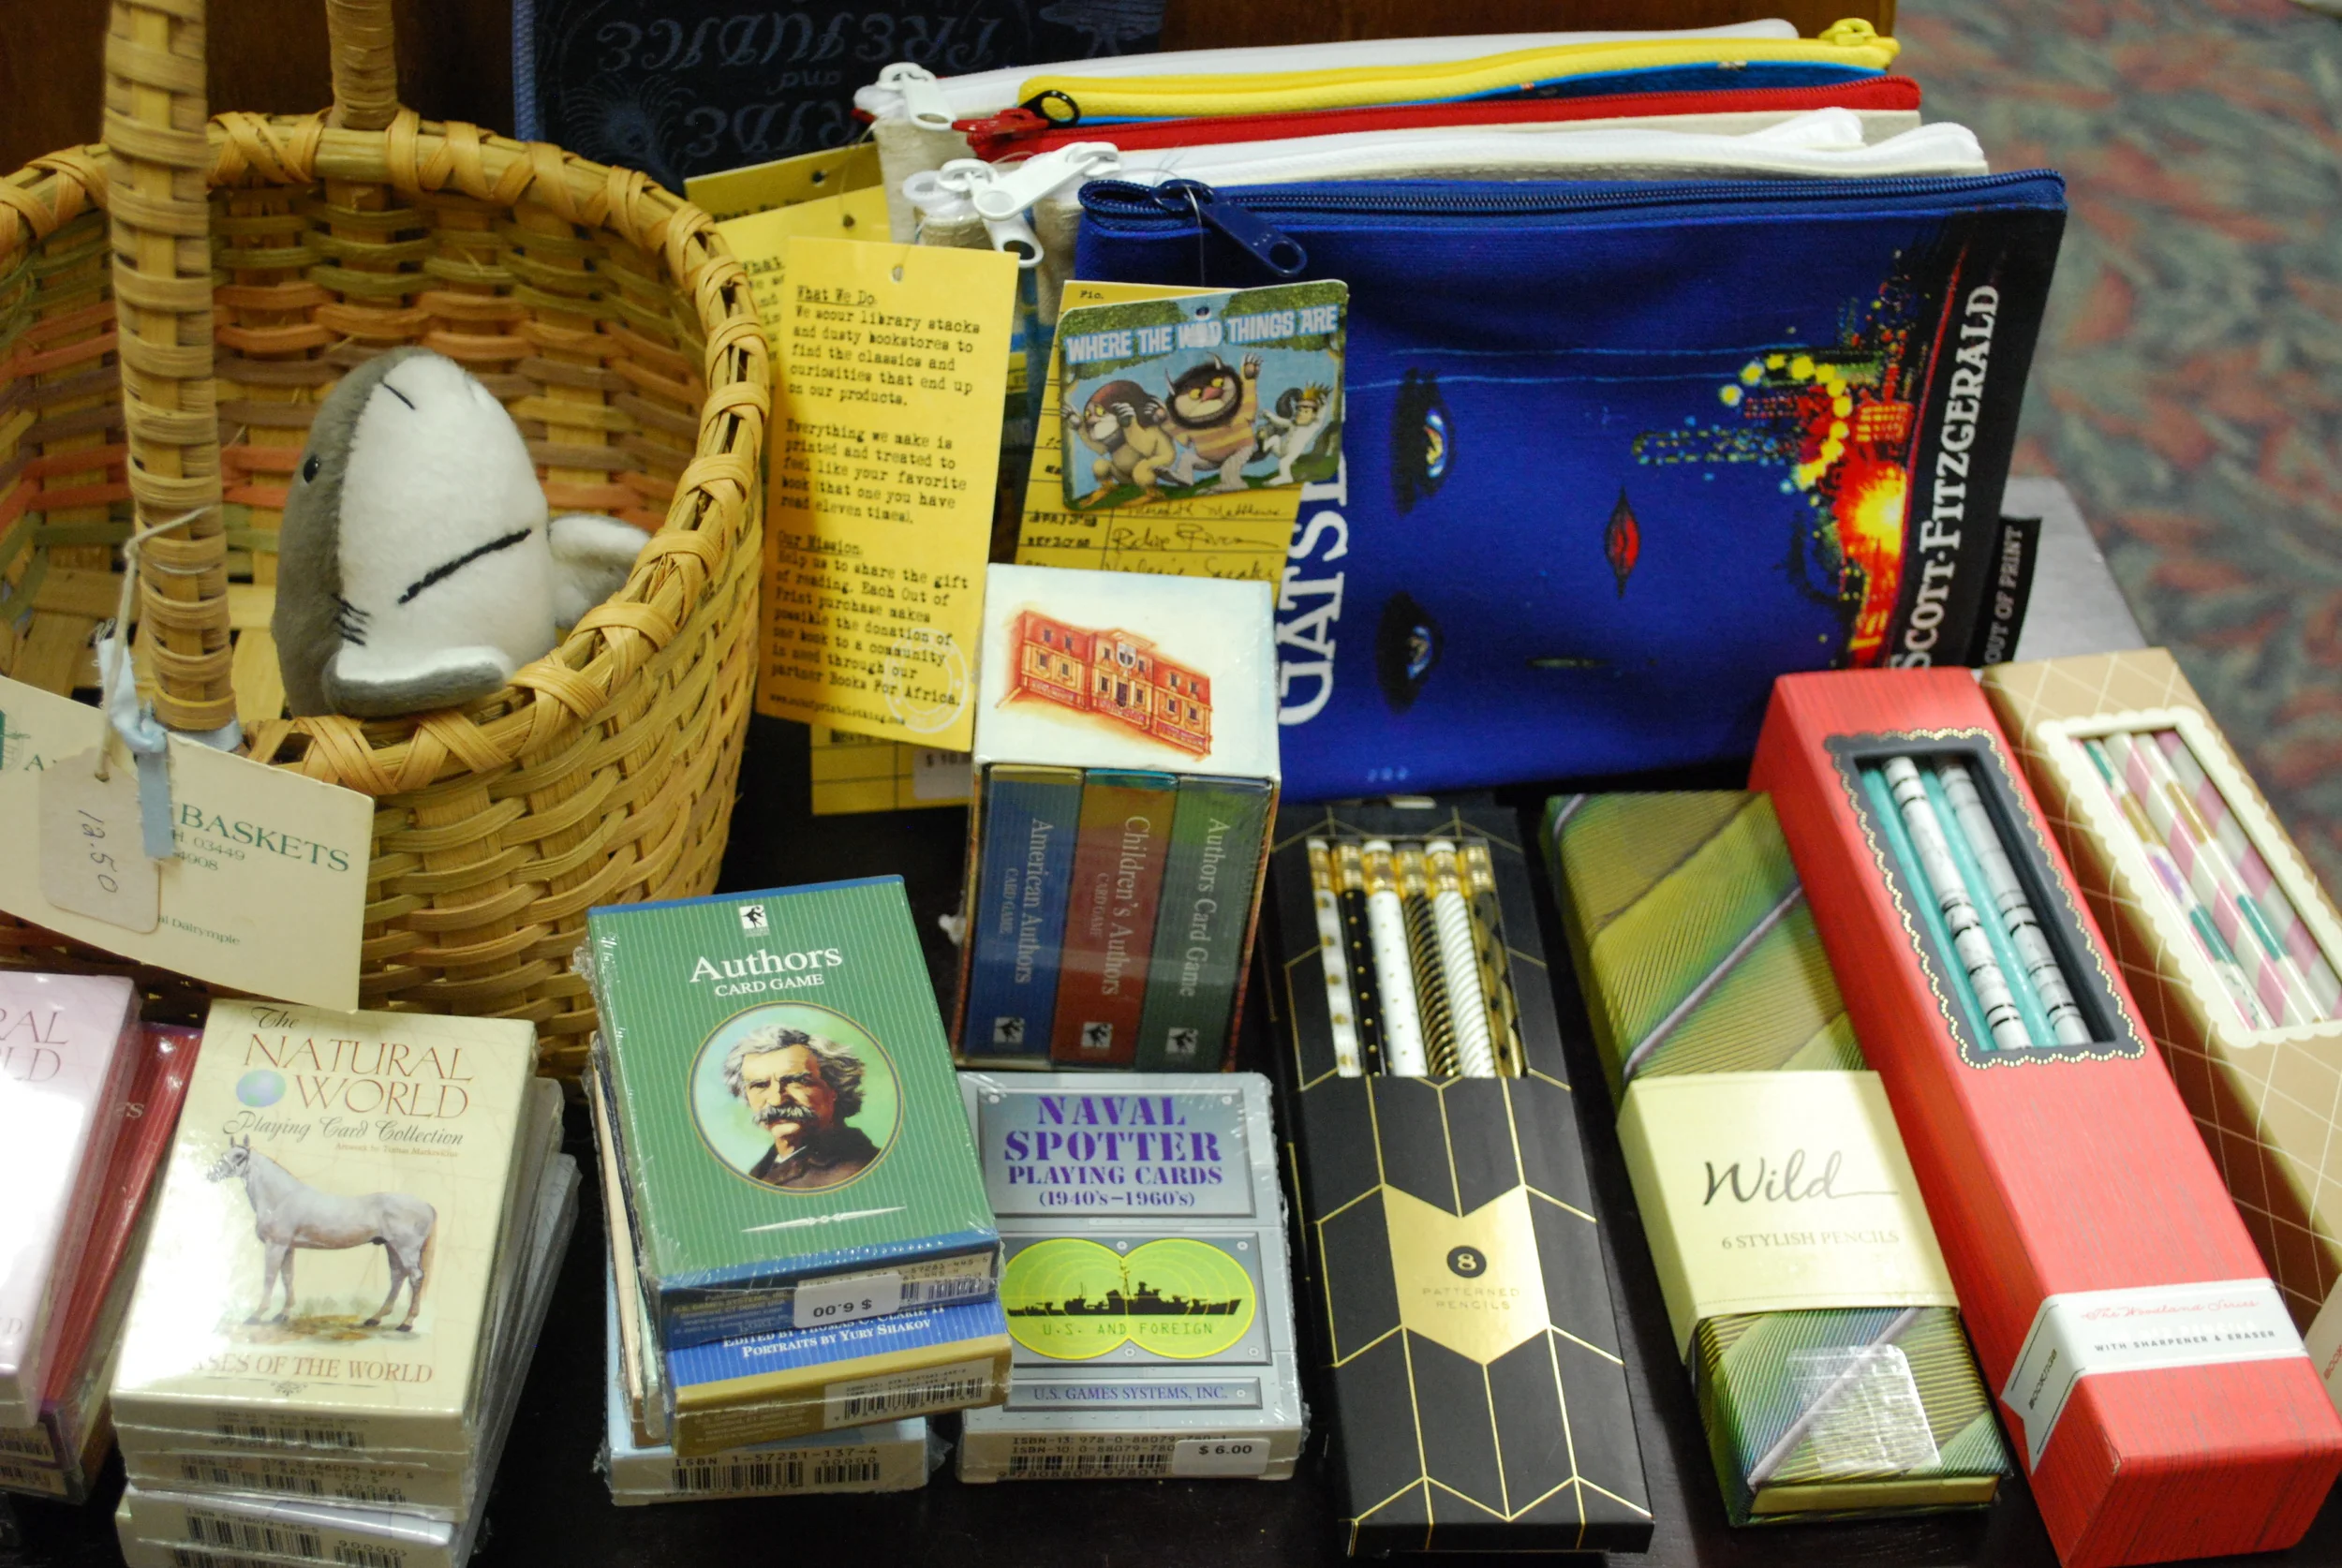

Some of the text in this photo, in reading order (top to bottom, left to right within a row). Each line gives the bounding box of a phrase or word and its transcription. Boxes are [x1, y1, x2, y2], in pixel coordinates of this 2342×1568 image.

[684, 98, 862, 158] RIDE
[796, 285, 828, 303] What
[816, 308, 853, 323] scour
[860, 309, 921, 331] library
[928, 317, 981, 334] stacks
[1063, 303, 1340, 364] WHERE THE WD THINGS ARE
[793, 325, 973, 353] and dusty bookstores to
[792, 343, 956, 371] find the classics and
[790, 363, 973, 395] curiosities that end up
[788, 383, 909, 407] on our products.
[786, 419, 953, 450] Everything we make is
[785, 438, 956, 470] printed and treated to
[783, 457, 967, 492] feel like your favorite
[780, 494, 810, 510] read
[815, 498, 862, 518] eleven
[781, 476, 809, 490] book
[857, 485, 882, 500] one
[886, 490, 912, 507] you
[919, 492, 956, 510] have
[813, 556, 969, 591] us to share the gift
[775, 585, 930, 624] Print purchase makes
[796, 572, 854, 595] reading.
[861, 582, 896, 599] Each
[902, 588, 927, 604] Out
[934, 592, 952, 608] of
[1984, 621, 2009, 664] OUT
[1998, 525, 2023, 588] PRINT
[836, 614, 860, 632] the
[864, 621, 930, 644] donation
[937, 629, 954, 645] of
[801, 629, 947, 667] book to a community
[827, 653, 919, 681] through our
[771, 661, 961, 708] partner Books For Africa.
[179, 803, 350, 873] BASKETS
[193, 836, 245, 861] 03449
[1015, 818, 1055, 984] American Authors
[1101, 815, 1151, 997] Children's Authors
[1179, 817, 1232, 998] Authors Card Game
[689, 946, 844, 984] Authors
[714, 972, 825, 998] CARD GAME
[250, 1006, 300, 1029] The
[243, 1032, 475, 1082] NATURAL
[294, 1073, 470, 1120] WORLD
[1037, 1096, 1187, 1126] NAVAL
[222, 1110, 465, 1146] Playing Card Collection
[1003, 1130, 1223, 1162] SPOTTER
[1008, 1164, 1223, 1186] PLAYING CARDS
[1702, 1148, 1901, 1206] Wild
[1721, 1229, 1901, 1250] 6 STYLISH PENCILS
[1457, 1252, 1477, 1271] 8
[1421, 1286, 1520, 1297] PATTERNED
[1435, 1299, 1511, 1310] PENCILS
[811, 1297, 873, 1319] $ 6.00
[2080, 1297, 2260, 1322] The Woodland Series
[742, 1318, 933, 1358] PORTRAITS BY YURY SHAKOV
[1042, 1322, 1214, 1337] U.S. AND FOREIGN
[2095, 1341, 2128, 1353] WITH
[2133, 1336, 2209, 1350] SHARPENER
[2214, 1334, 2222, 1342] &
[2227, 1329, 2276, 1342] ERASER
[256, 1355, 289, 1375] OF
[292, 1357, 341, 1379] THE
[348, 1360, 434, 1383] WORLD
[1033, 1385, 1228, 1402] U.S. GAMES SYSTEMS, INC.
[674, 1457, 719, 1467] ISBN
[1197, 1443, 1253, 1457] $ 6.00
